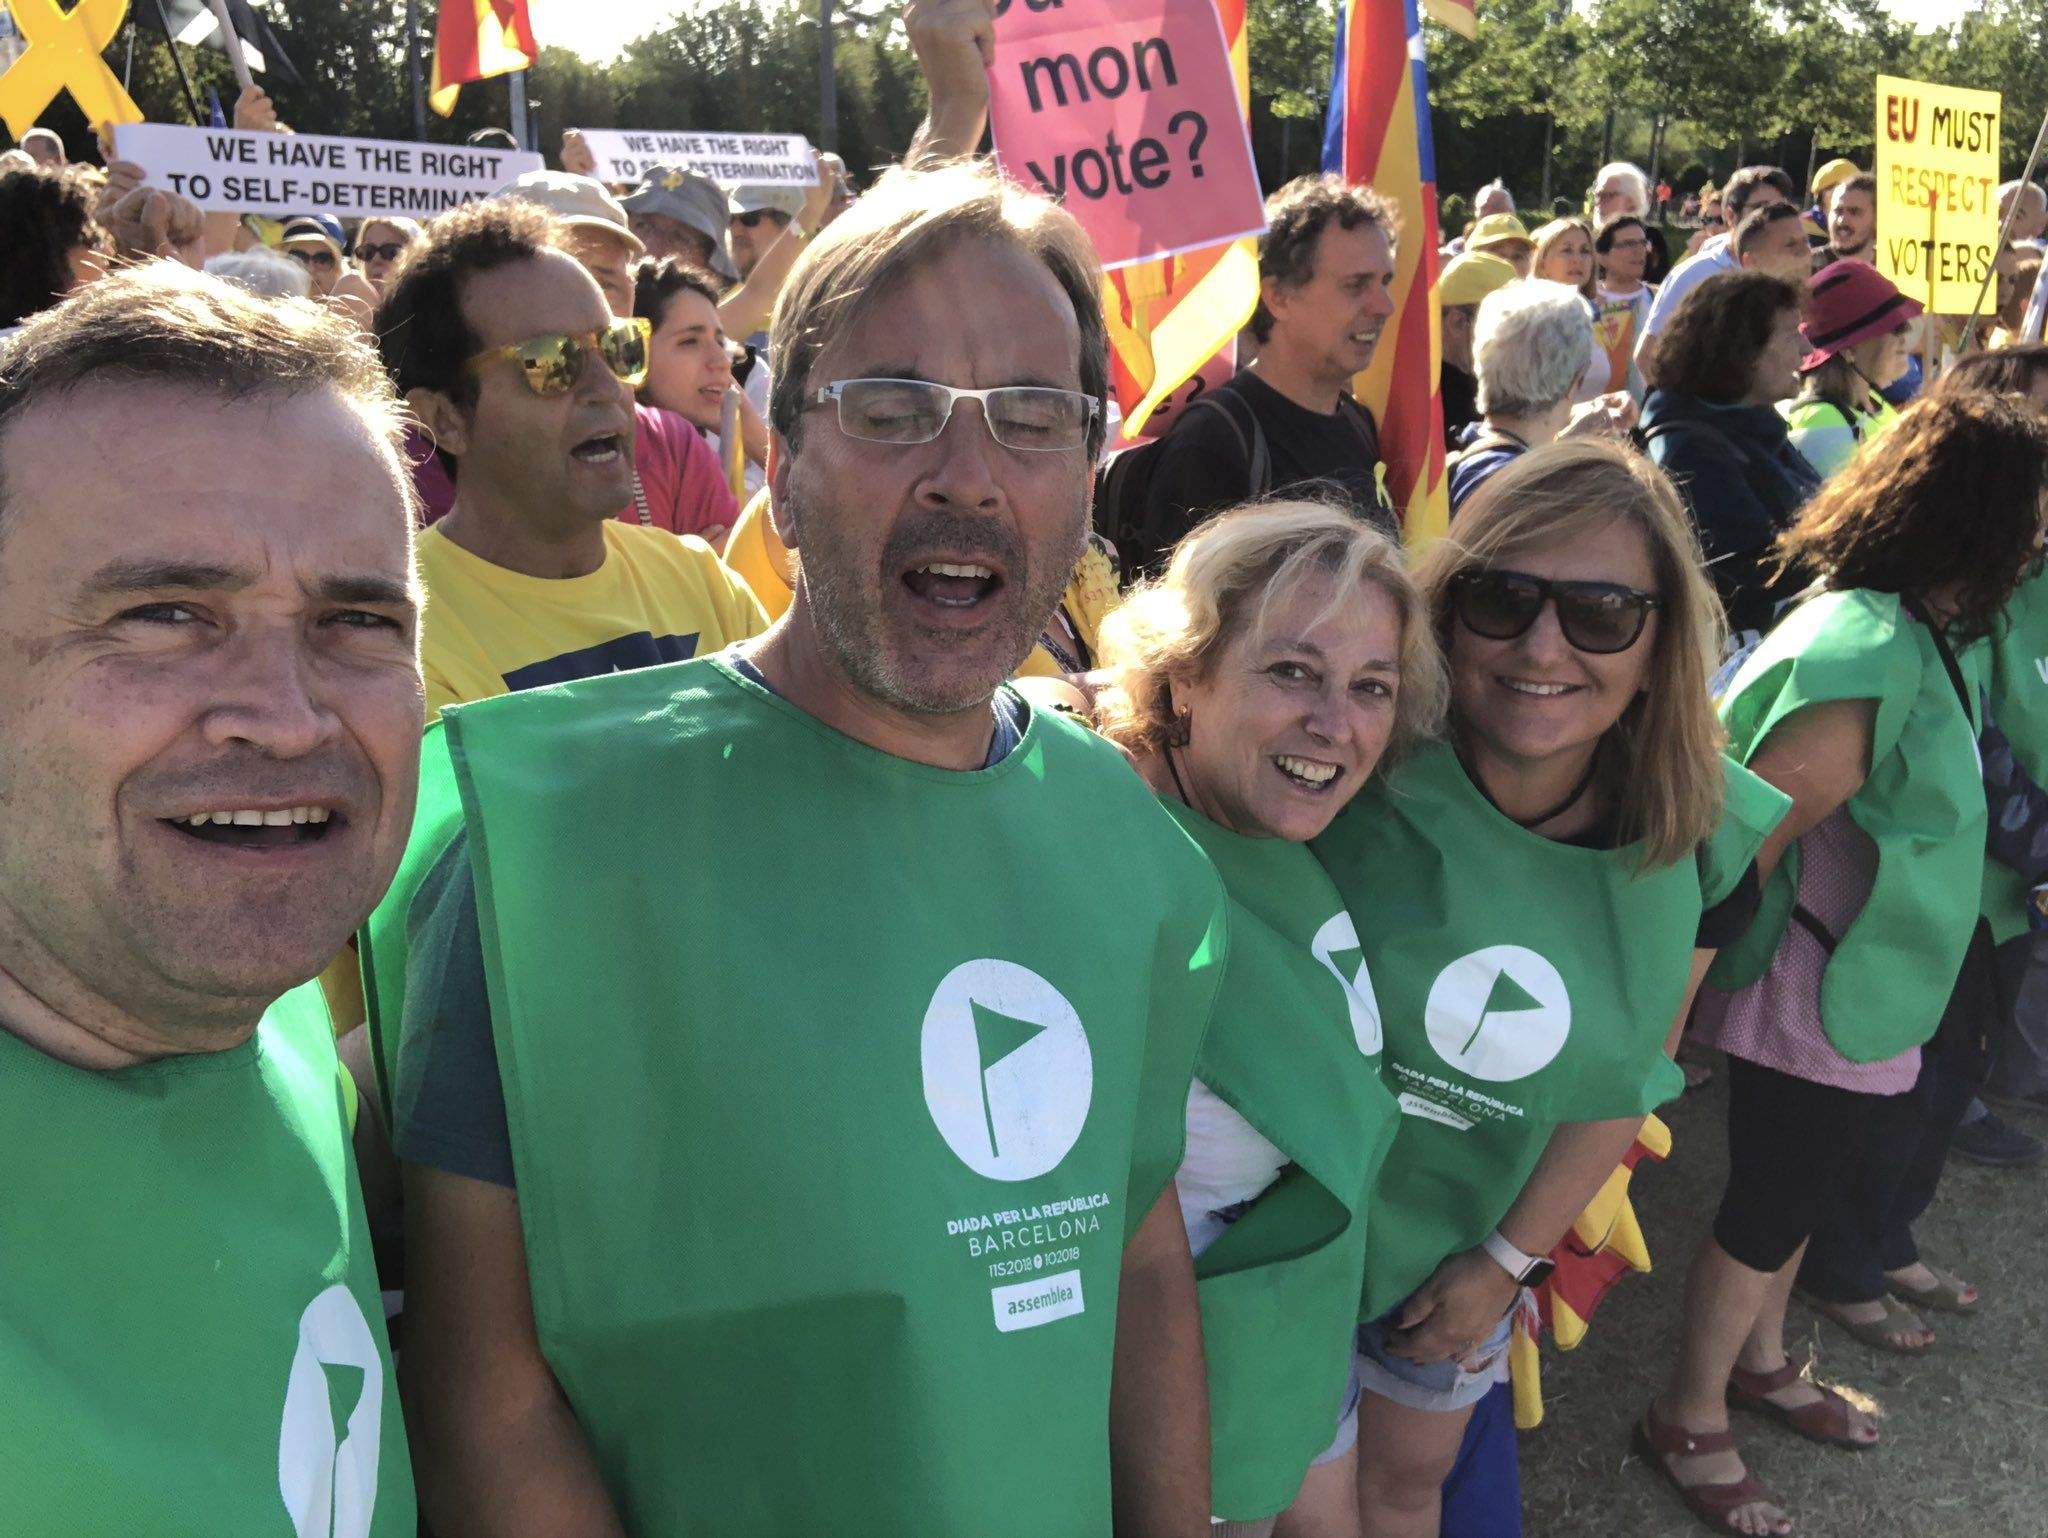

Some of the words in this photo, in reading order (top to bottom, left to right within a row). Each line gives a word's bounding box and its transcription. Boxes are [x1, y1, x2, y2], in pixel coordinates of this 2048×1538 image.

[1019, 36, 1178, 113] mon
[623, 135, 655, 153] WE
[656, 136, 704, 155] HAVE
[706, 138, 739, 156] THE
[743, 139, 789, 156] RIGHT
[1887, 94, 1919, 143] EU
[1932, 105, 1996, 154] MUST
[207, 136, 257, 163] WE
[268, 140, 346, 169] HAVE
[356, 147, 411, 173] THE
[421, 151, 503, 180] RIGHT
[610, 158, 636, 178] TO
[1025, 110, 1208, 203] vote?
[167, 172, 211, 199] TO
[1891, 164, 1993, 215] RESPECT
[1889, 237, 1991, 284] VOTERS
[1449, 1083, 1464, 1096] LA
[946, 1214, 992, 1236] DIADA
[993, 1209, 1021, 1227] PER
[1022, 1206, 1042, 1221] LA
[1042, 1193, 1110, 1218] REPÚBLICA
[968, 1214, 1100, 1257] BARCELONA
[1007, 1286, 1073, 1315] assemblea
